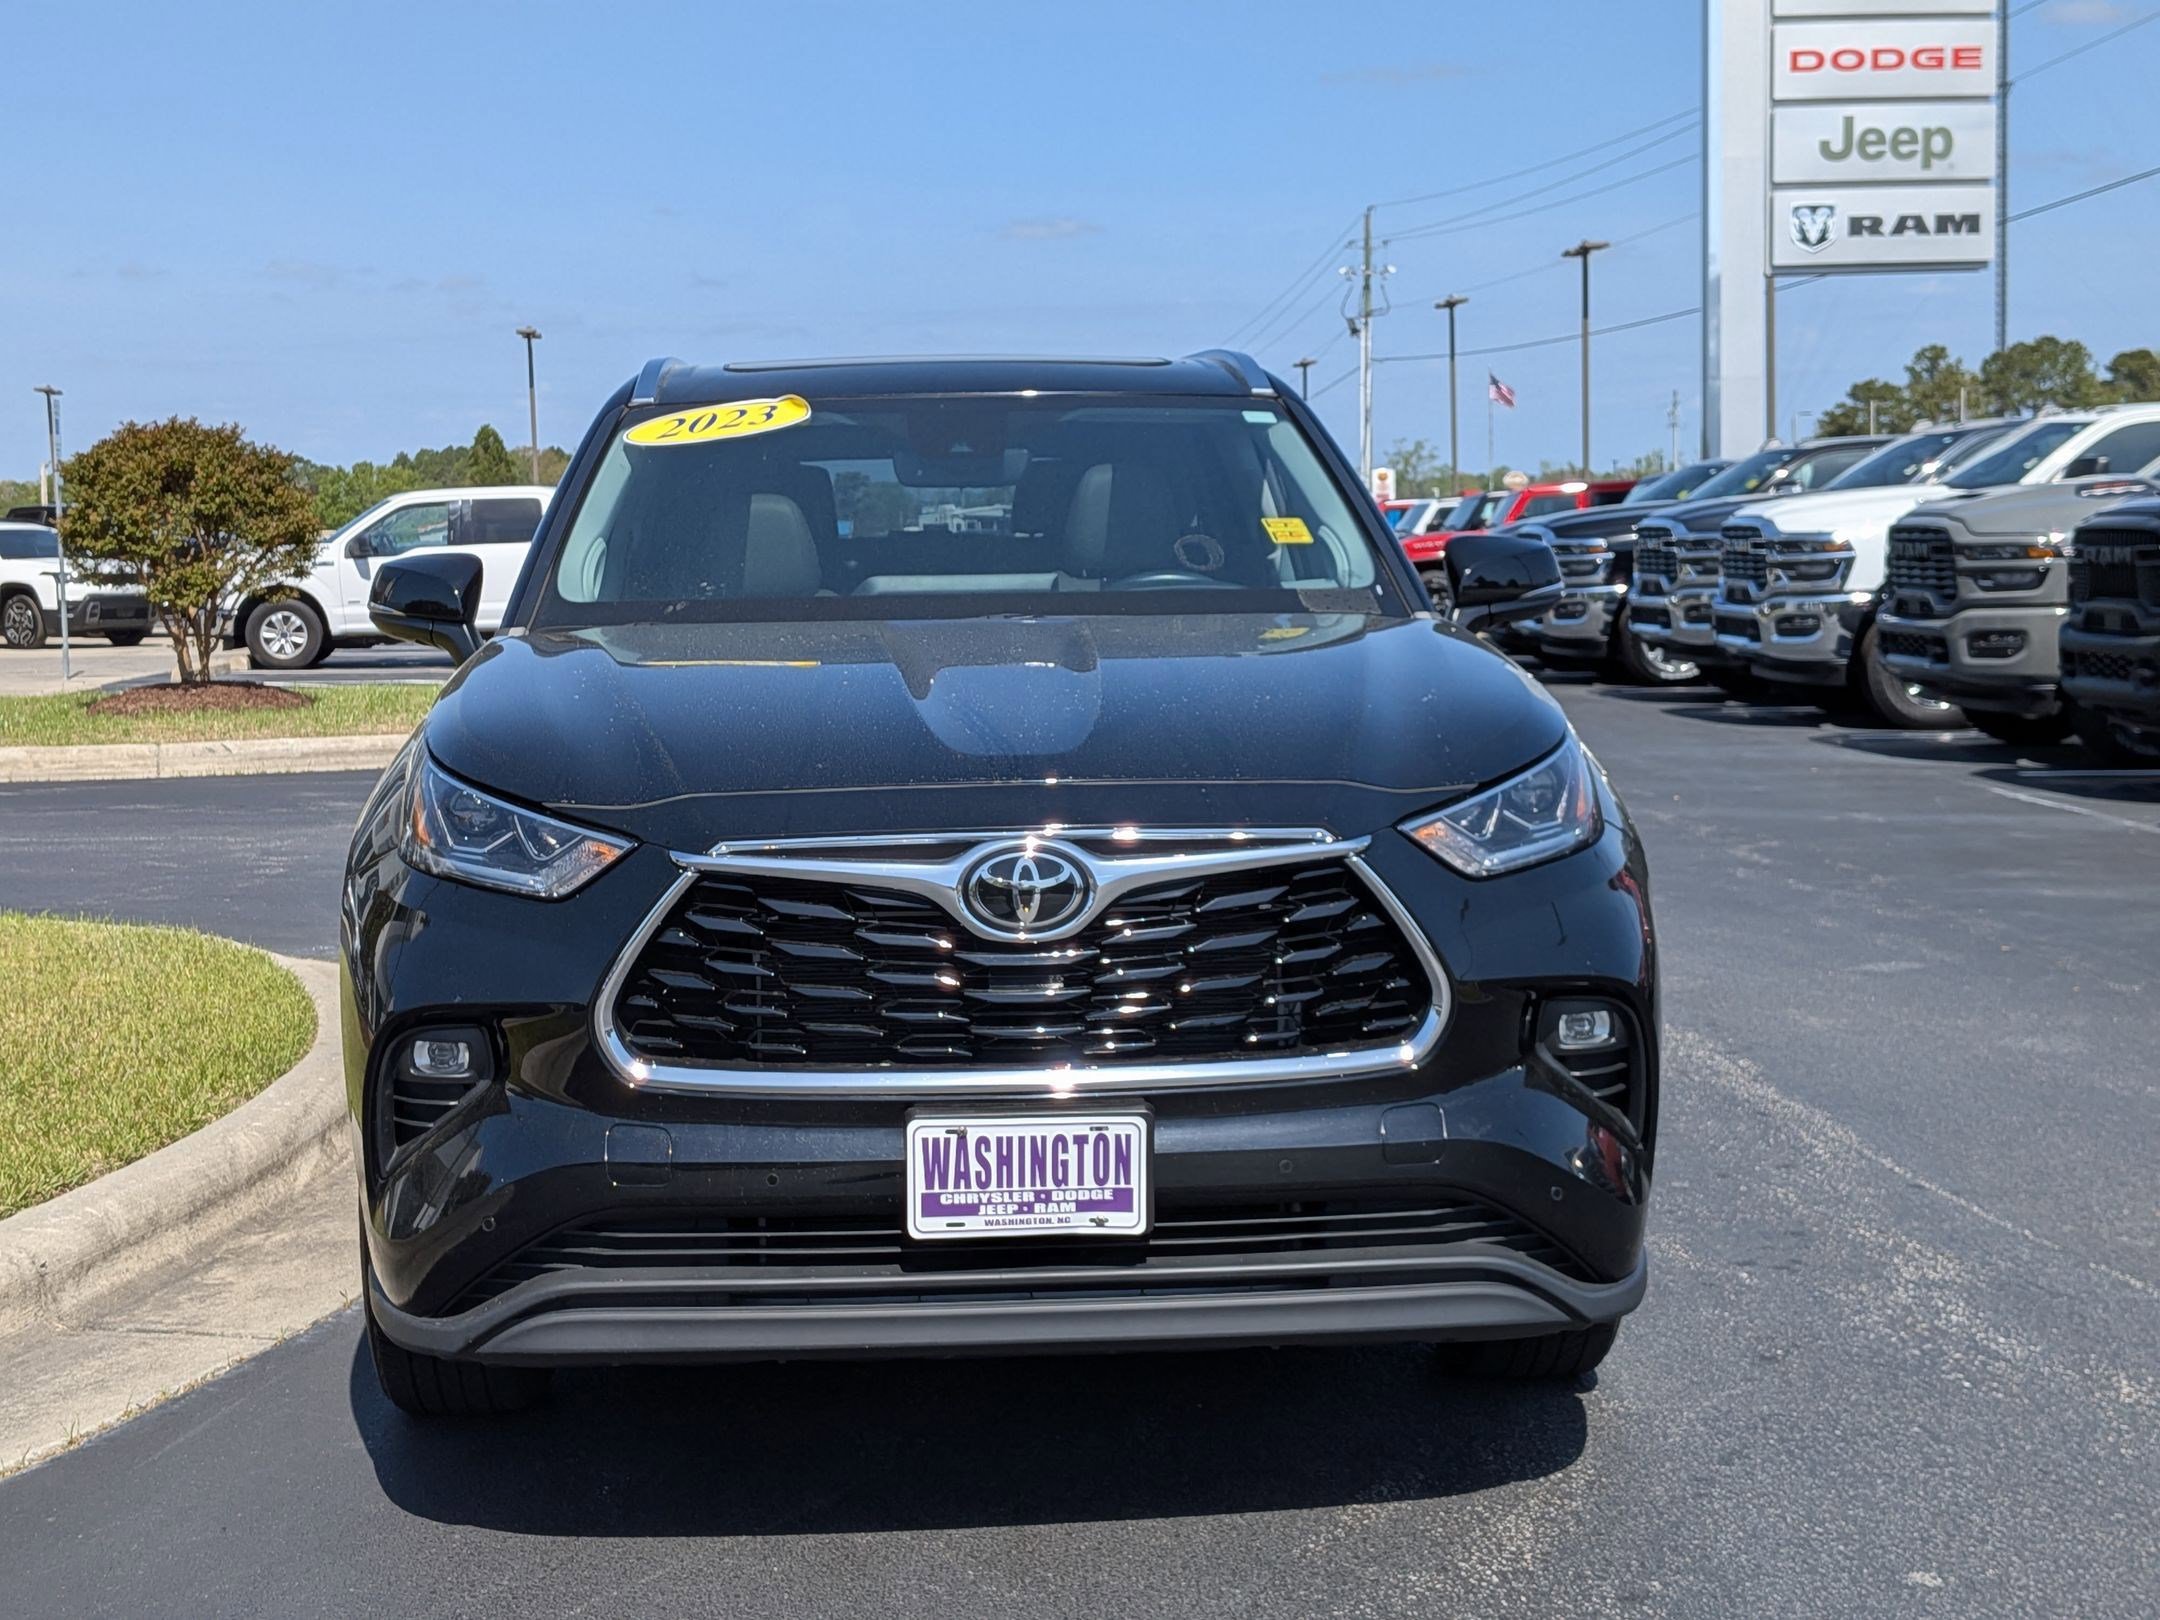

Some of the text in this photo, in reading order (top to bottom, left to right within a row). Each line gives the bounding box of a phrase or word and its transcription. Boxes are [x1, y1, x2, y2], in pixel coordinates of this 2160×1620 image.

[1789, 46, 1984, 73] DODGE
[1818, 115, 1954, 170] Jeep
[1847, 213, 1981, 238] RAM
[656, 405, 778, 440] 2023
[921, 1132, 1132, 1191] WASHINGTON
[940, 1188, 1115, 1205] CHRYSLER DODGE
[978, 1202, 1077, 1216] JEEP RAM
[1057, 1216, 1072, 1224] NC
